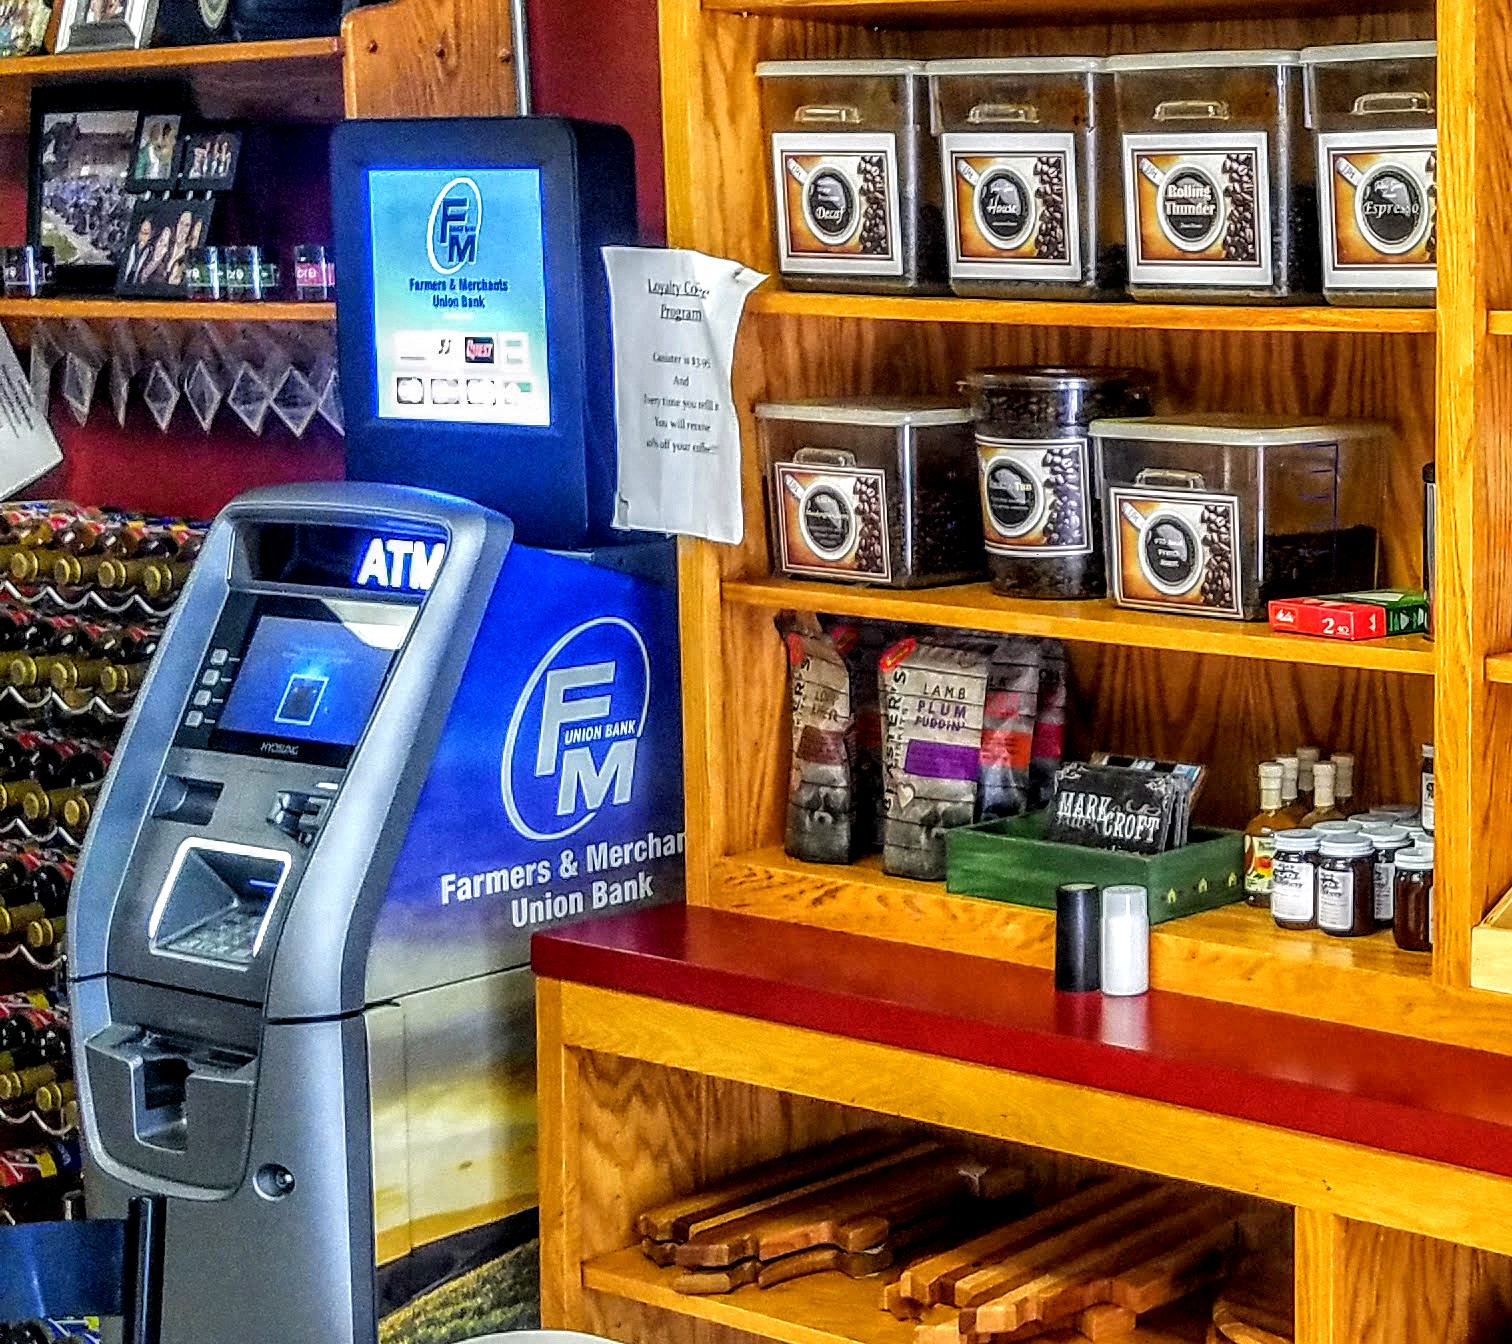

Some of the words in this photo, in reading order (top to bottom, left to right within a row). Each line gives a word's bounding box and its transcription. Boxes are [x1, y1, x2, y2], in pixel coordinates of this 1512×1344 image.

[1167, 183, 1212, 201] Rolling
[815, 206, 845, 224] Decaf
[1164, 201, 1216, 217] Thunder
[1362, 199, 1420, 219] Espresso
[409, 277, 447, 291] Farmers
[458, 278, 509, 292] Merchants
[647, 279, 682, 297] Loyalty
[432, 294, 459, 308] Union
[461, 295, 486, 309] Bank
[660, 303, 702, 322] Program
[672, 375, 690, 387] And
[653, 416, 668, 428] You
[670, 418, 686, 429] will
[356, 537, 446, 590] ATM
[1321, 618, 1335, 635] 2
[923, 683, 967, 700] LAMB
[916, 700, 967, 719] PLUM
[535, 661, 616, 778] F
[563, 723, 603, 745] UNION
[604, 719, 637, 738] BANK
[556, 738, 638, 816] M
[1057, 791, 1112, 822] MARK
[1103, 811, 1160, 844] CROFT
[440, 859, 551, 905] Farmers
[559, 848, 579, 879] &
[510, 890, 584, 929] Union
[592, 871, 654, 907] Bank
